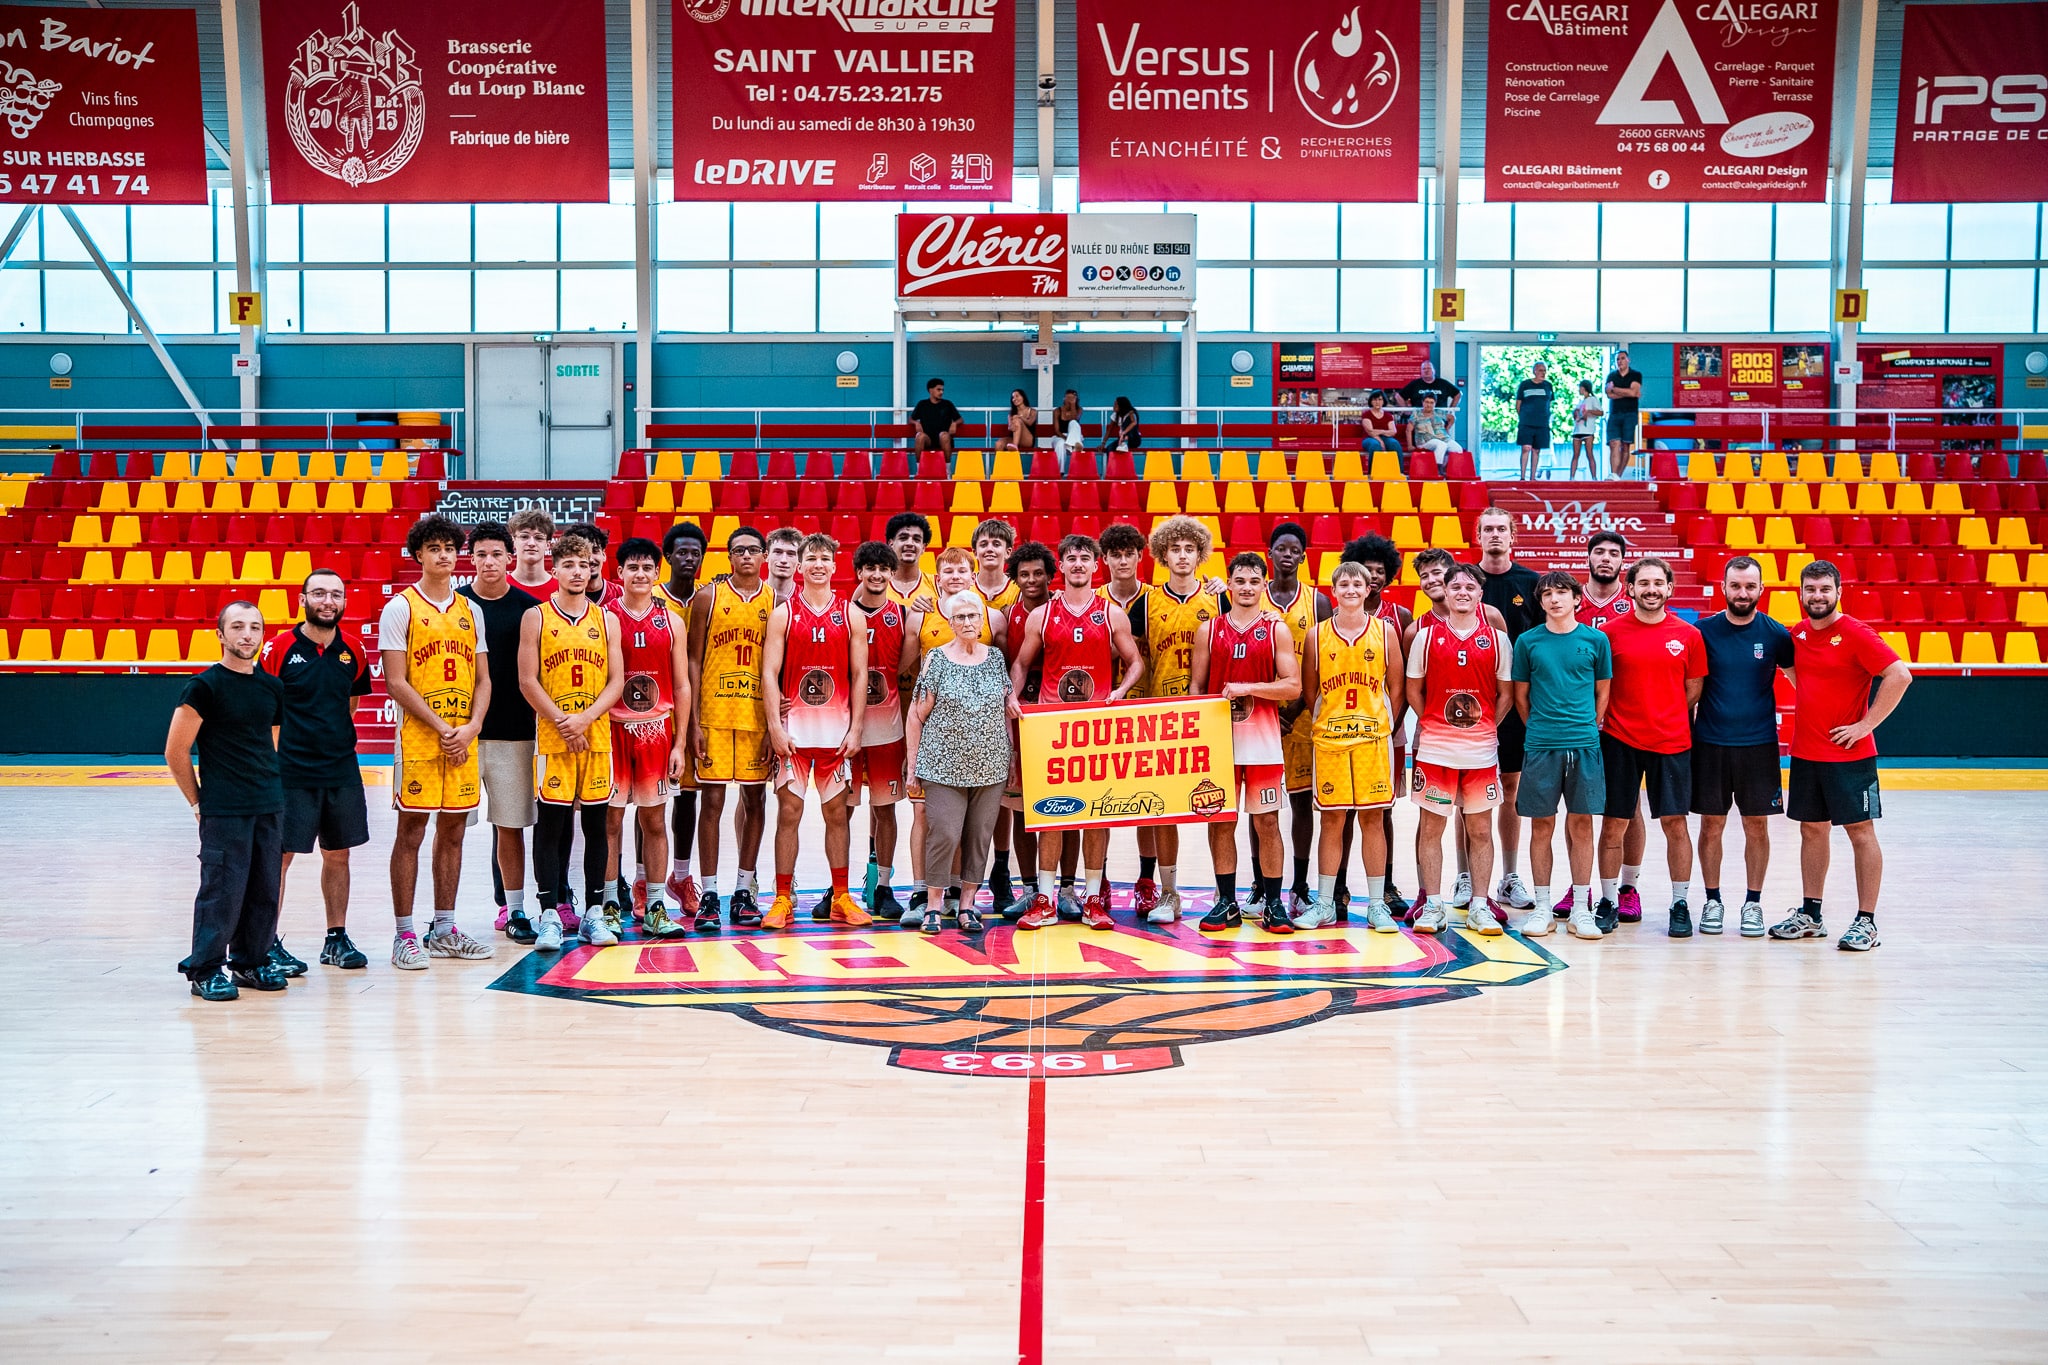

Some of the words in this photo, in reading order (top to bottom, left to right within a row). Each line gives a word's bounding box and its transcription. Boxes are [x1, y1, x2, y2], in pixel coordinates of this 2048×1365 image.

[874, 21, 970, 31] SUPER
[1554, 23, 1629, 36] Bâtiment
[40, 17, 155, 70] Bariot
[448, 39, 532, 54] Brasserie
[1097, 23, 1250, 76] Versus
[448, 59, 558, 79] Coopérative
[713, 49, 817, 73] SAINT
[834, 49, 974, 73] VALLIER
[1505, 62, 1574, 72] Construction
[1576, 64, 1609, 72] neuve
[1714, 62, 1765, 73] Carrelage
[1775, 62, 1815, 73] Parquet
[1505, 77, 1565, 87] Rénovation
[1729, 77, 1759, 87] Pierre
[1769, 76, 1814, 87] Sanitaire
[448, 81, 472, 96] du
[479, 80, 527, 100] Loup
[532, 80, 585, 96] Blanc
[745, 85, 775, 102] Tel
[794, 85, 943, 103] 04.75.23.21.75
[1108, 82, 1249, 111] éléments
[1504, 93, 1530, 102] Pose
[1532, 92, 1546, 102] de
[1549, 92, 1600, 104] Carrelage
[1772, 91, 1813, 101] Terrasse
[81, 91, 111, 107] Vins
[114, 91, 139, 107] fins
[308, 107, 333, 129] 20
[376, 109, 398, 131] 15
[1504, 107, 1541, 117] Piscine
[69, 112, 155, 130] Champagnes
[712, 117, 733, 131] Du
[736, 116, 774, 131] lundi
[777, 120, 795, 131] au
[799, 117, 852, 132] samedi
[855, 117, 874, 132] de
[877, 118, 915, 132] 8h30
[918, 117, 926, 132] à
[931, 118, 975, 133] 19h30
[450, 130, 510, 148] Fabrique
[514, 130, 531, 145] de
[534, 129, 570, 145] bière
[1618, 128, 1652, 138] 26600
[1654, 128, 1705, 139] GERVANS
[1912, 130, 1999, 142] PARTAGE
[2006, 130, 2030, 141] DE
[1110, 137, 1249, 158] ÉTANCHÉITÉ
[1260, 136, 1282, 160] &
[1300, 137, 1392, 147] RECHERCHES
[1617, 142, 1632, 153] 04
[1635, 142, 1651, 153] 75
[1654, 142, 1669, 153] 68
[1672, 142, 1688, 153] 00
[1690, 142, 1705, 153] 44
[3, 151, 42, 166] SUR
[48, 152, 146, 167] HERBASSE
[951, 154, 964, 165] 24
[1300, 148, 1392, 159] D'INFILTRATIONS
[951, 169, 964, 180] 24
[1502, 165, 1563, 175] CALEGARI
[1566, 165, 1622, 175] Bâtiment
[1704, 166, 1764, 176] CALEGARI
[1767, 166, 1808, 178] Design
[20, 174, 57, 194] 47
[66, 174, 100, 195] 41
[111, 174, 149, 195] 74
[1503, 180, 1620, 190] contact@calegaribatiment.fr
[1702, 180, 1808, 191] contact@calegaridesign.fr
[906, 215, 1064, 277] Chérie
[1071, 242, 1102, 255] VALLÉE
[1105, 244, 1117, 255] DU
[1120, 242, 1149, 255] RHÔNE
[1031, 274, 1059, 294] FM
[1078, 284, 1186, 292] www.cheriefmvalleedurhone.fr
[237, 297, 253, 320] F
[1440, 293, 1457, 317] E
[1842, 293, 1860, 318] D
[1731, 353, 1773, 369] 2003
[556, 364, 600, 377] SORTIE
[1737, 370, 1773, 384] 2006
[442, 492, 513, 509] CENTRE
[634, 632, 646, 648] 11
[812, 626, 826, 643] 14
[1073, 627, 1083, 643] 6
[735, 645, 752, 667] 10
[1233, 643, 1247, 659] 10
[1457, 651, 1467, 666] 5
[443, 659, 457, 681] 8
[571, 665, 584, 687] 6
[1346, 689, 1357, 709] 9
[1052, 711, 1200, 749] JOURNÉE
[1047, 745, 1211, 785] SOUVENIR
[888, 781, 898, 796] 7
[1260, 788, 1276, 804] 10
[1486, 783, 1497, 800] 5
[1043, 798, 1075, 813] Ford
[942, 1053, 1135, 1072] 1993
